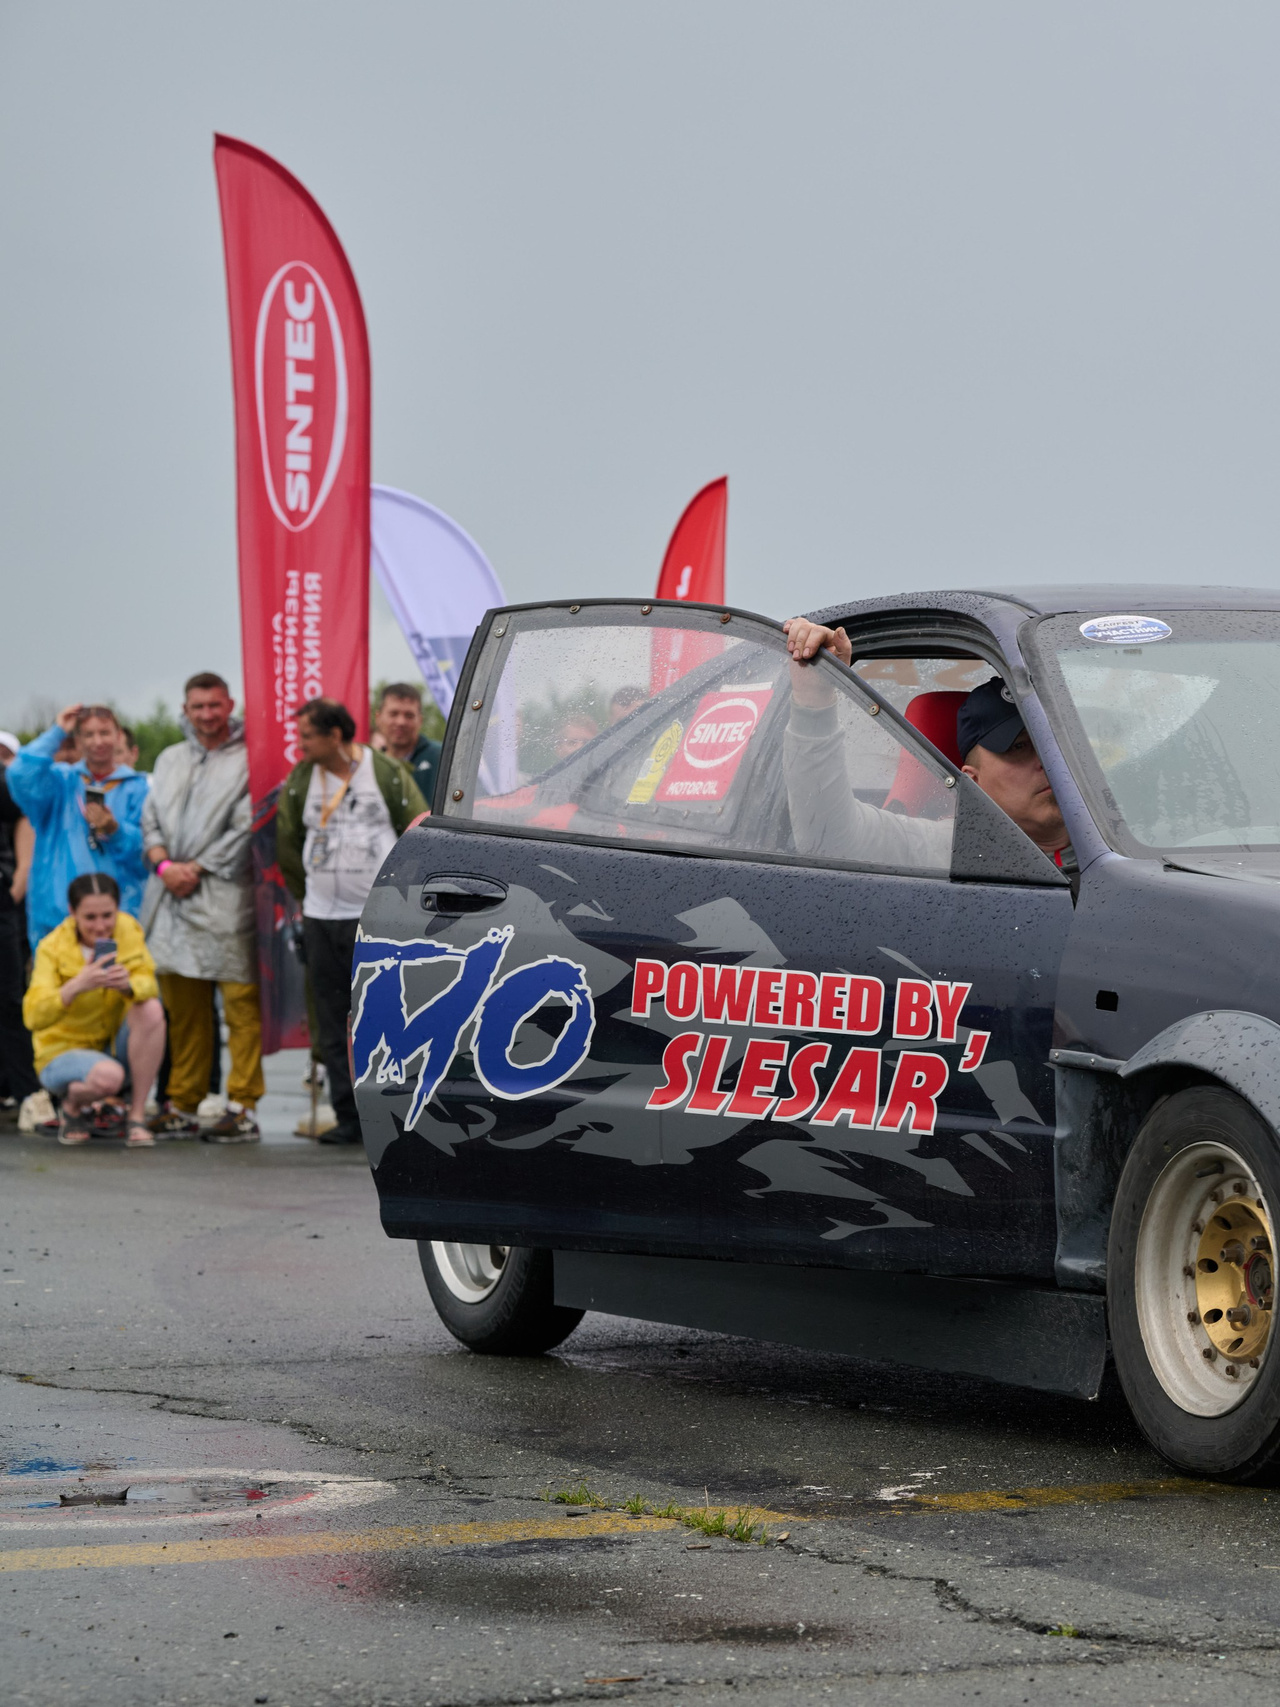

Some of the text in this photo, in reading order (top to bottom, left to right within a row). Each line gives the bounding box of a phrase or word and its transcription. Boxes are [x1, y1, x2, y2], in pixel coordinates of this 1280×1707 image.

[283, 279, 315, 513] SINTEC
[1094, 626, 1163, 638] УЧАСТНИК
[688, 720, 753, 744] SINTEC
[665, 781, 703, 796] MOTOR
[702, 780, 718, 796] OIL
[631, 958, 884, 1036] POWERED
